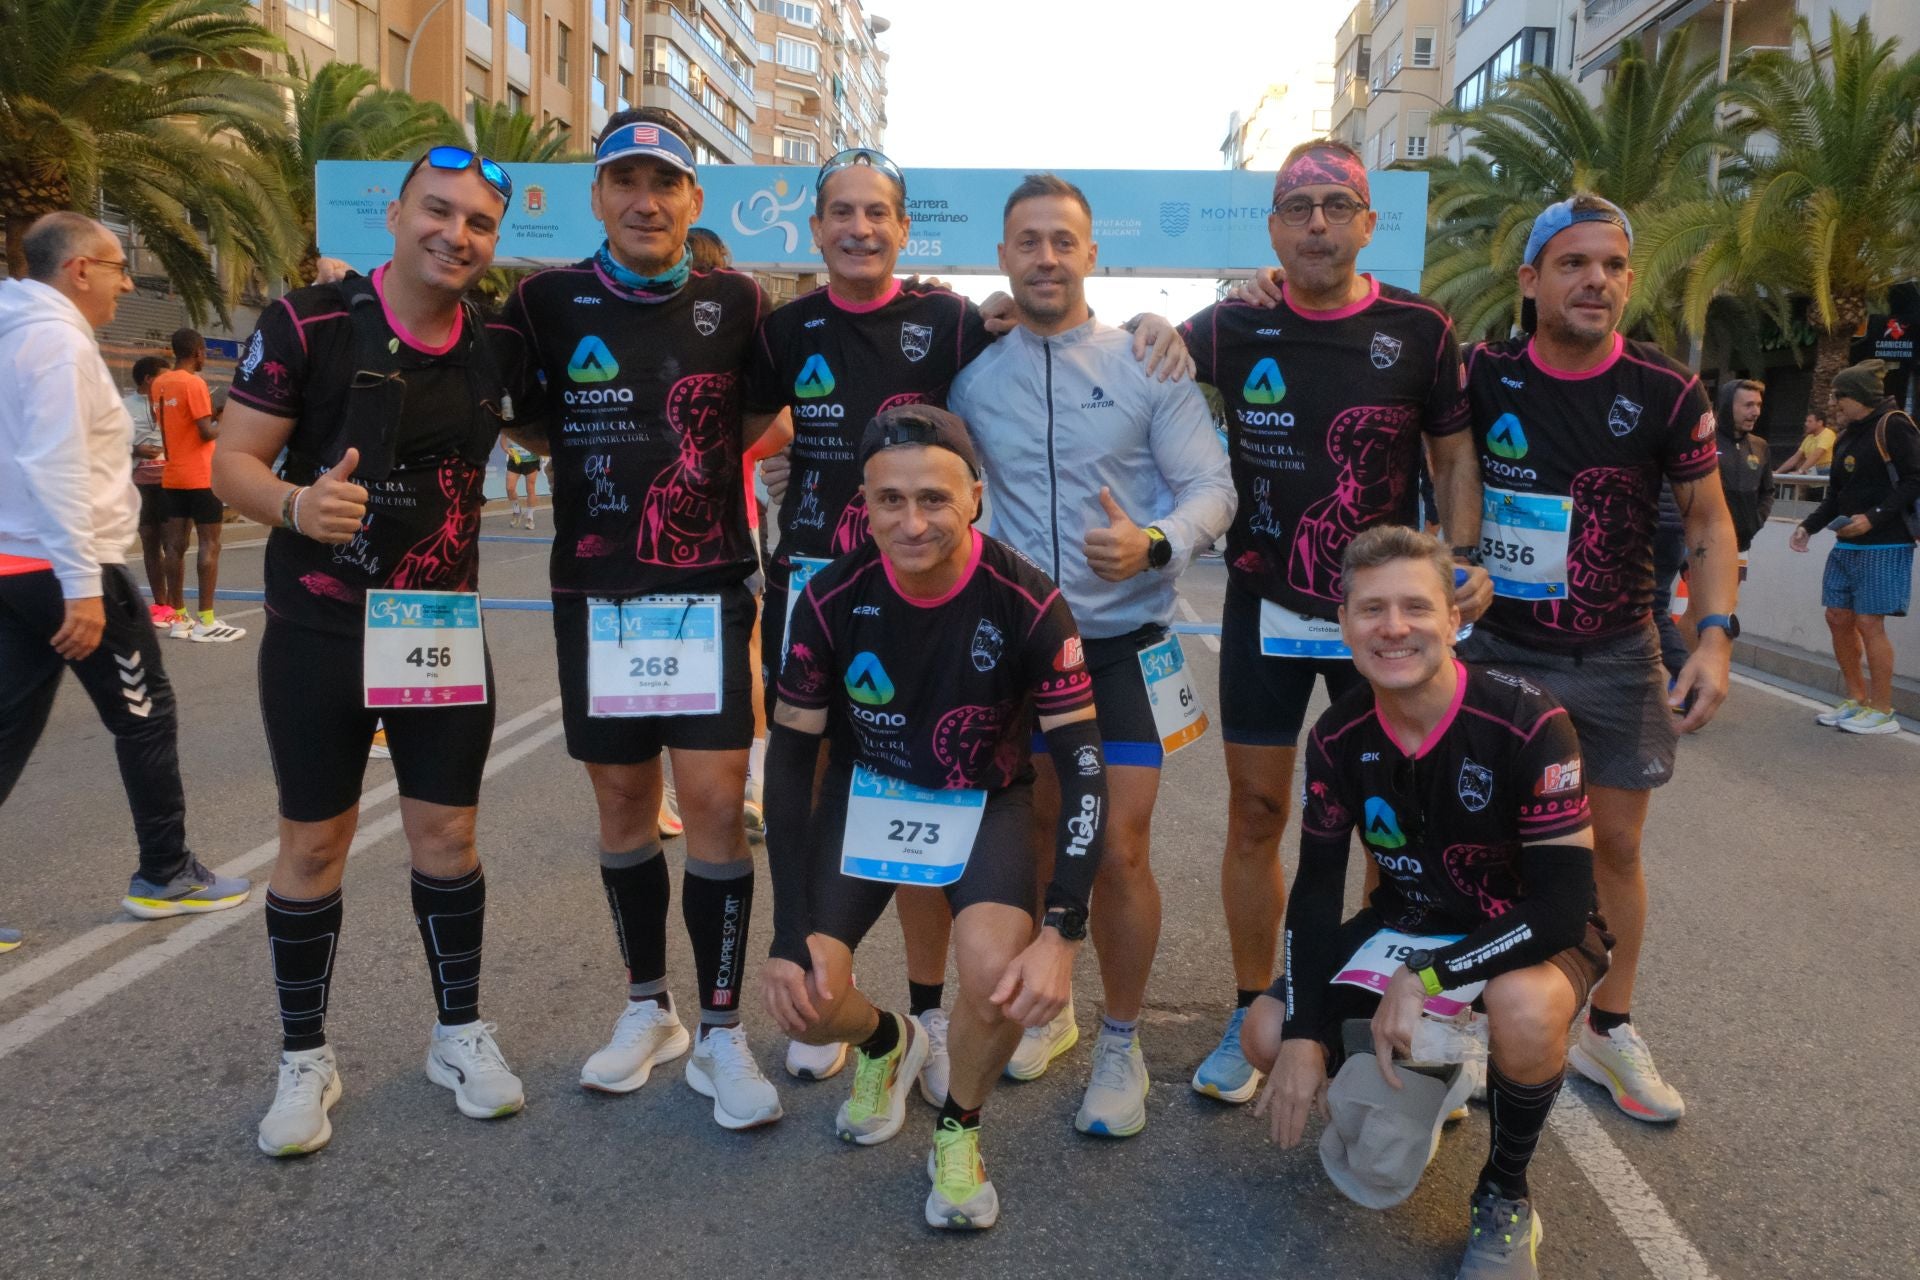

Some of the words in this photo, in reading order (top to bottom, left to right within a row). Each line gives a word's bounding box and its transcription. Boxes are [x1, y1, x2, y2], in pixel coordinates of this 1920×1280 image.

[1200, 207, 1272, 220] MONTEM
[1081, 400, 1115, 409] VIATOR
[1482, 537, 1535, 566] 3536
[401, 603, 423, 619] VI
[1308, 625, 1340, 633] Cristóbal
[406, 646, 452, 668] 456
[629, 656, 680, 678] 268
[888, 819, 941, 845] 273
